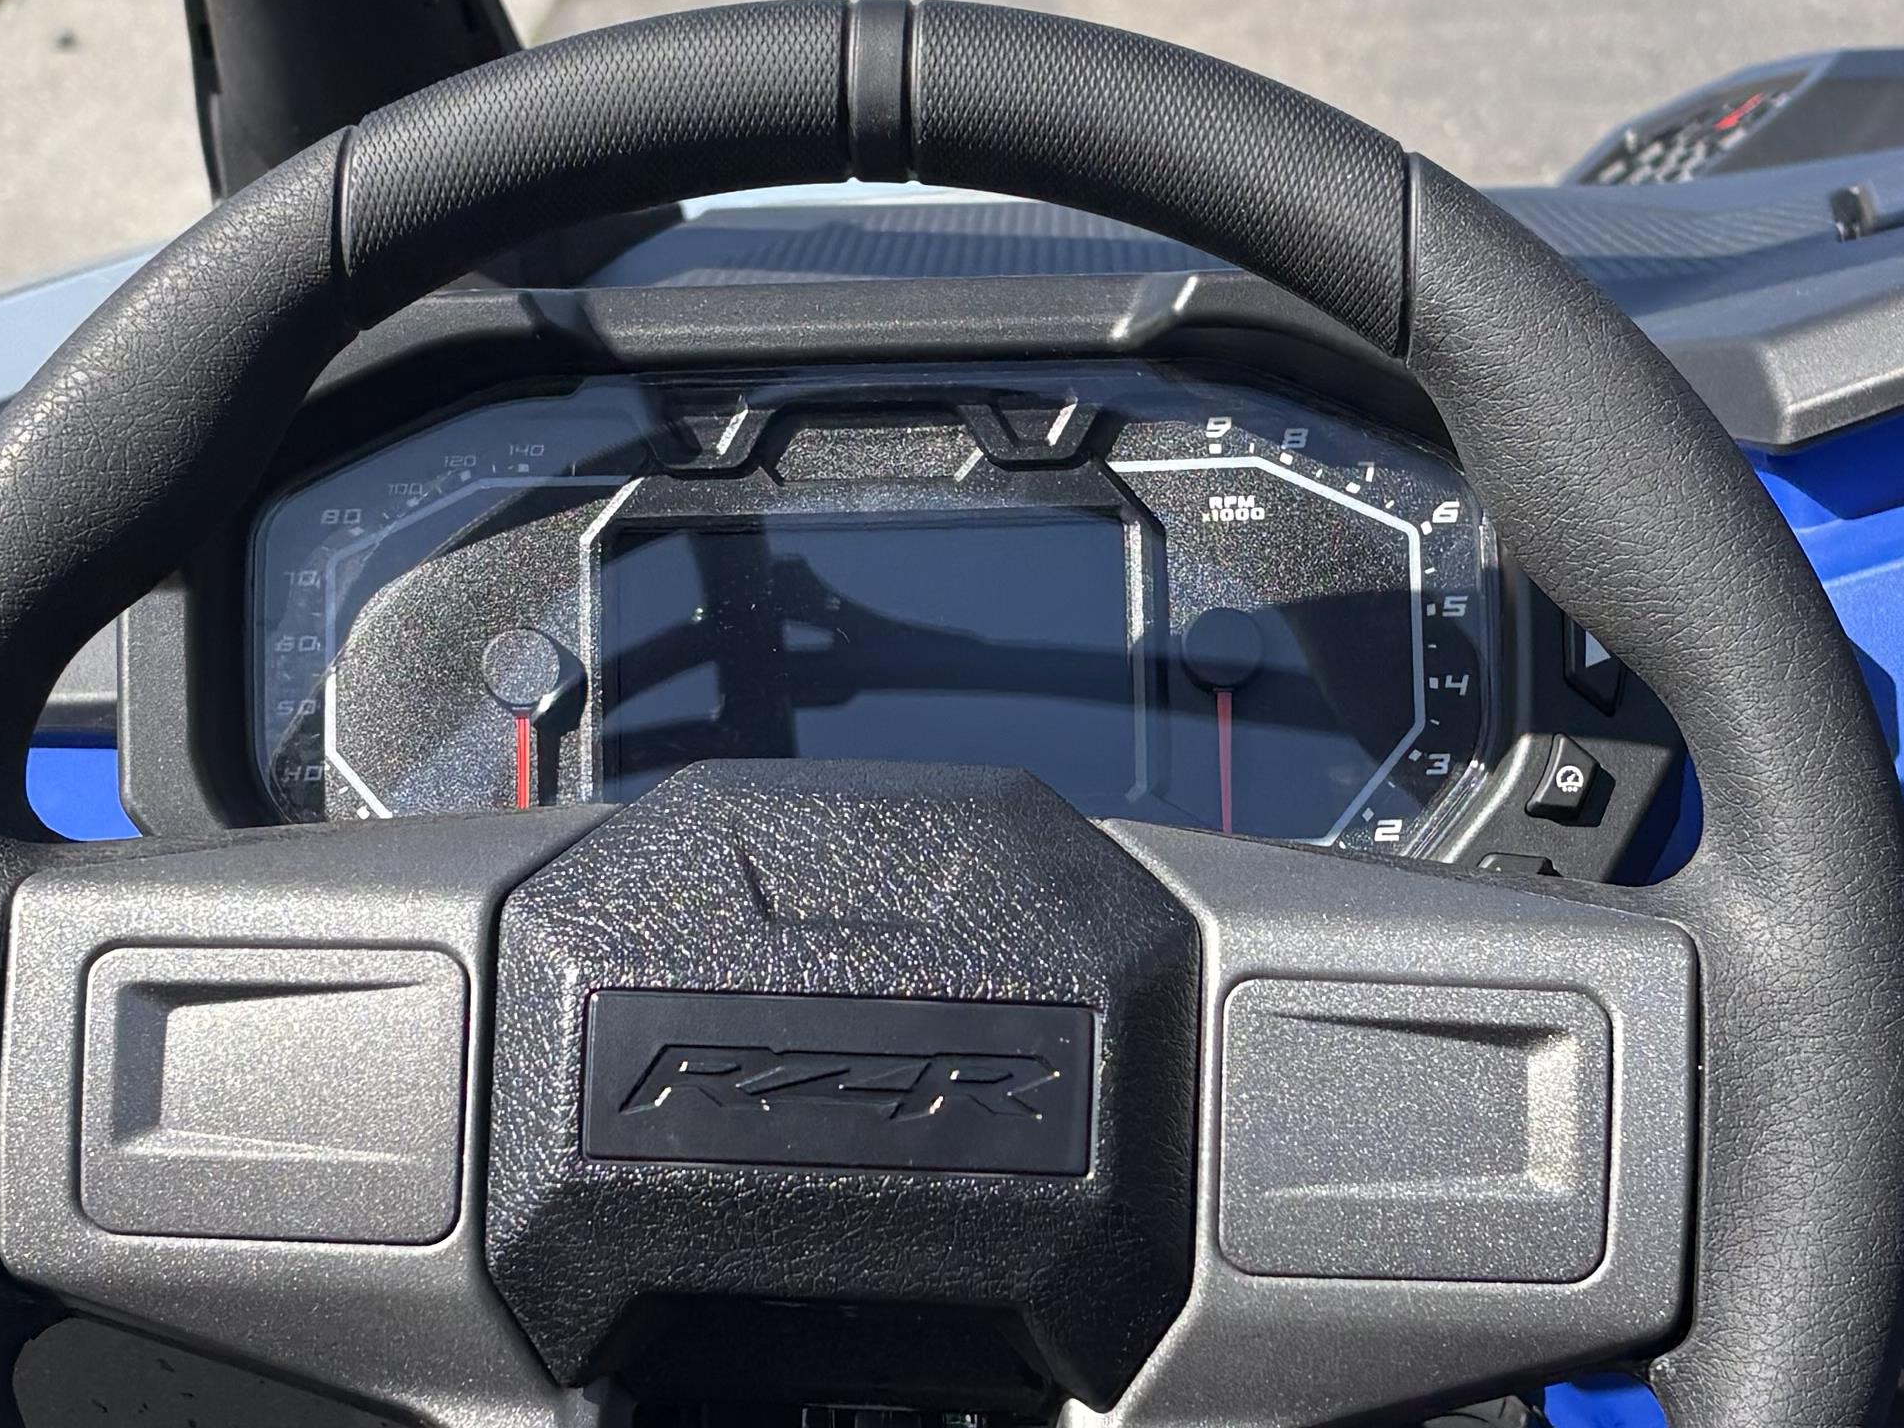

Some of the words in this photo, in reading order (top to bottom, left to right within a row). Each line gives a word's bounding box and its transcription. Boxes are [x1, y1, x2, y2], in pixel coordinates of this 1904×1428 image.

[1206, 416, 1232, 439] 9
[1282, 428, 1309, 449] 8
[445, 455, 477, 468] 120
[509, 444, 545, 457] 140
[1358, 461, 1376, 483] 7
[387, 483, 424, 496] 100
[1209, 495, 1256, 510] RPM
[1432, 501, 1461, 524] 6
[321, 509, 362, 525] 80
[1442, 595, 1469, 617] 5
[1444, 674, 1470, 697] 4
[277, 699, 317, 716] 50
[1425, 753, 1452, 776] 3
[1373, 819, 1403, 842] 2
[618, 1043, 1061, 1123] RZR
